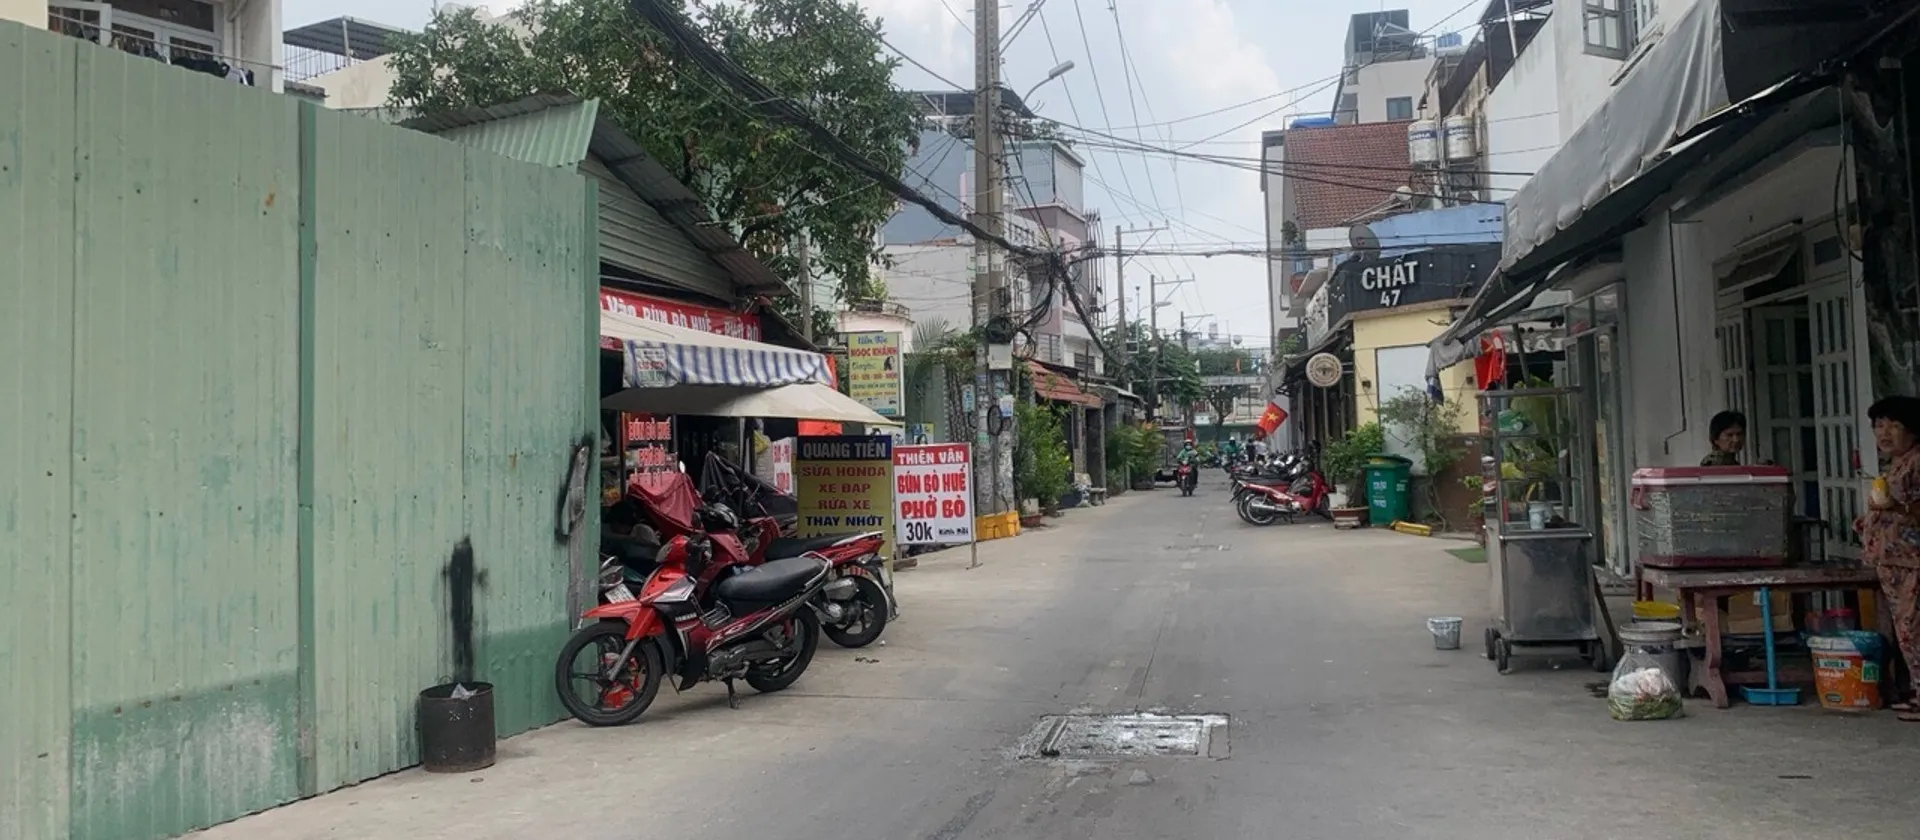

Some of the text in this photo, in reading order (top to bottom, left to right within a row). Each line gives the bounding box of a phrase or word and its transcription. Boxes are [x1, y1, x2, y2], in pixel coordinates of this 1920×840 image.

[1361, 254, 1418, 290] CHẤT
[1380, 289, 1401, 307] 47
[803, 442, 850, 459] QUANG
[897, 447, 964, 465] THIÊN VÂN
[836, 466, 886, 477] HONDA
[897, 464, 967, 494] BÚN BÒ HUẾ
[818, 483, 871, 496] XE ĐẠP
[852, 499, 871, 510] XE
[901, 494, 966, 520] PHỞ BÒ
[805, 513, 884, 527] THAY NHỚT
[906, 521, 933, 541] 30k
